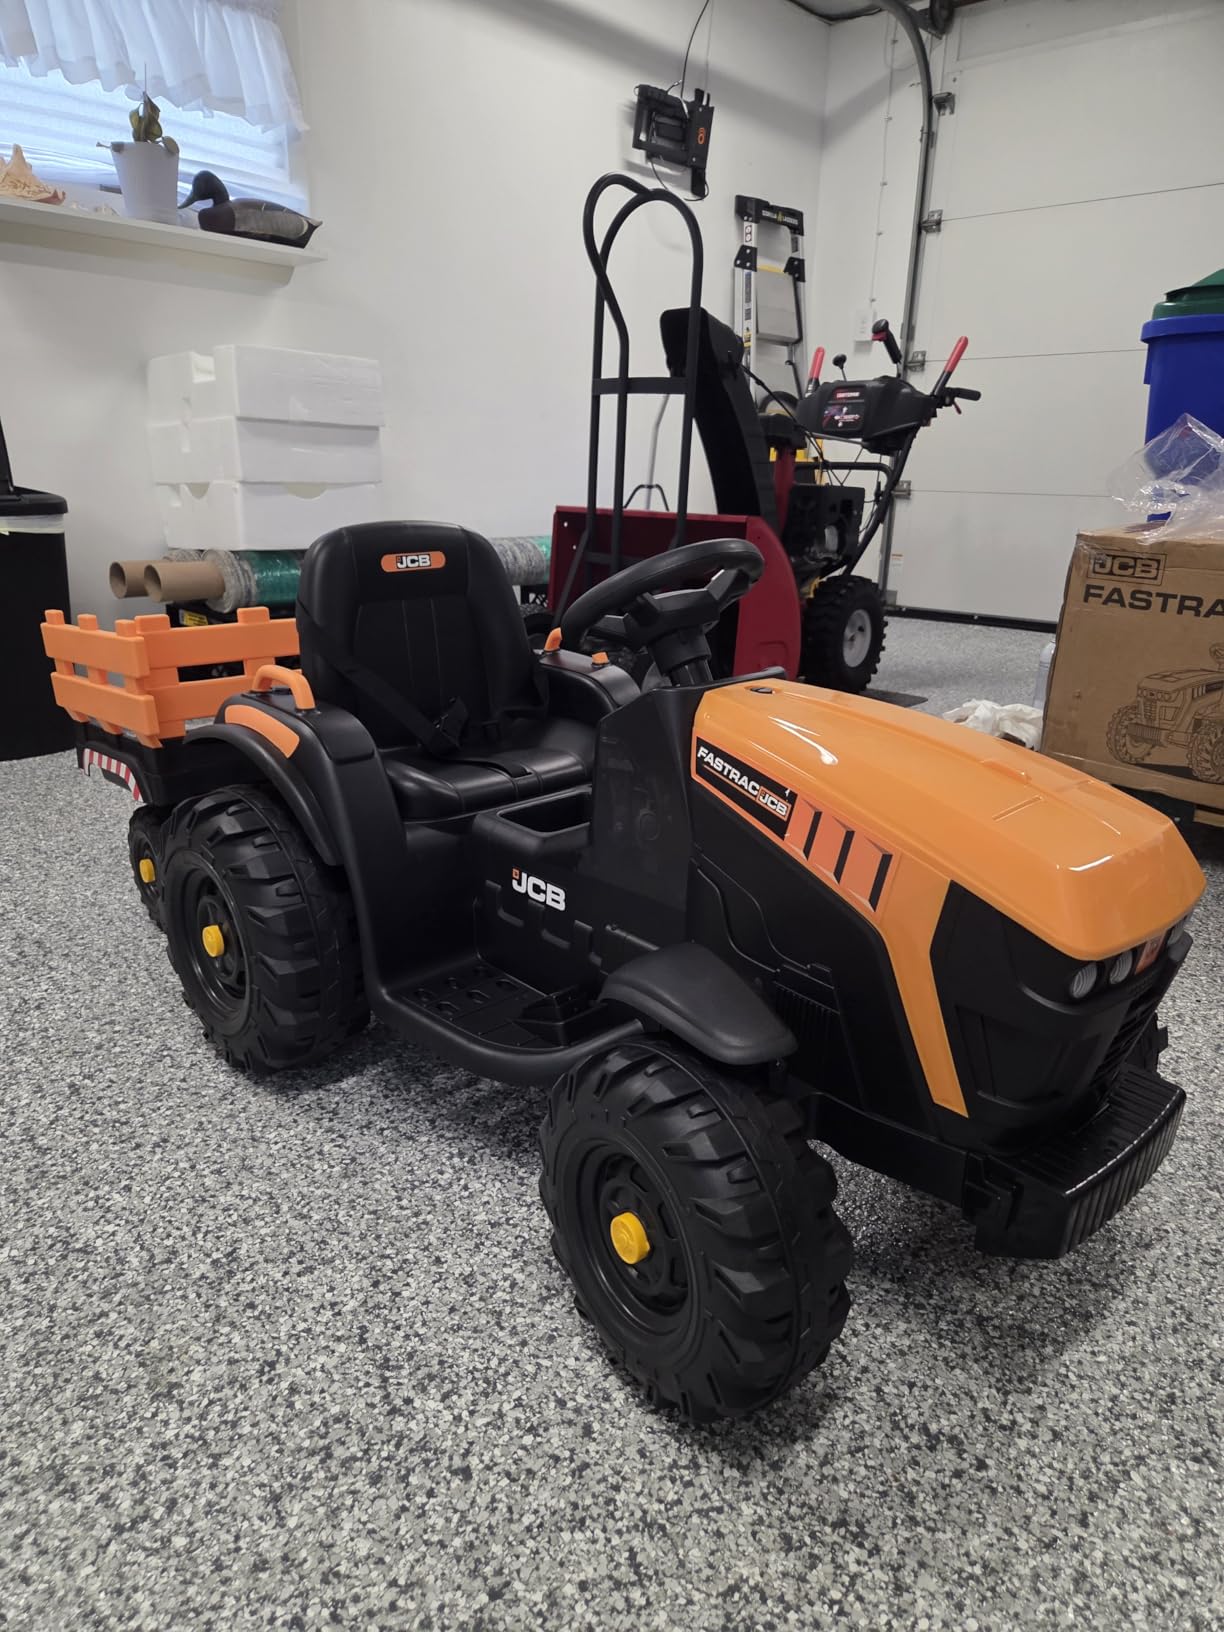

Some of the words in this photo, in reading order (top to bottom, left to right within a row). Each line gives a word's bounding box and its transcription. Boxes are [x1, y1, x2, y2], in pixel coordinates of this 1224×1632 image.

[397, 554, 431, 569] JCB
[1092, 553, 1160, 580] JCB
[1083, 583, 1224, 618] FASTRA
[697, 746, 760, 796] FASTRAC
[759, 793, 788, 816] JCB
[512, 869, 566, 911] JCB
